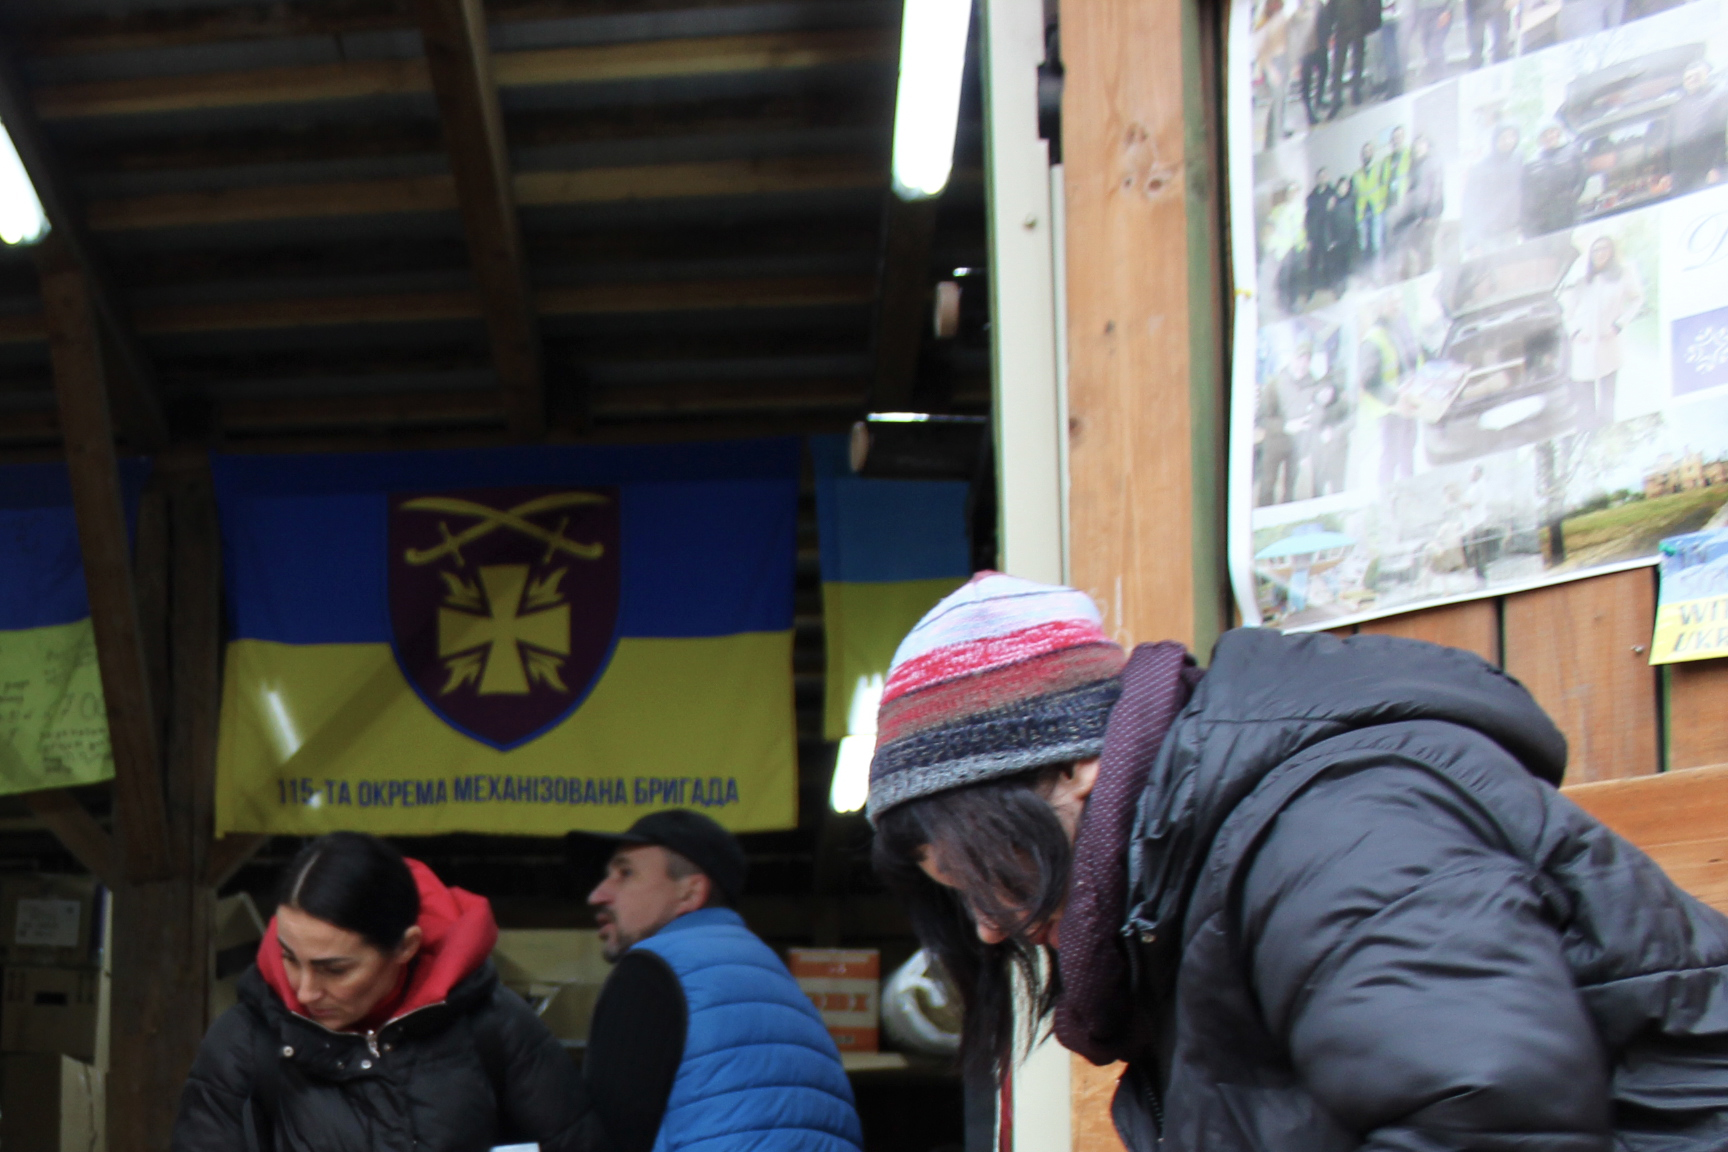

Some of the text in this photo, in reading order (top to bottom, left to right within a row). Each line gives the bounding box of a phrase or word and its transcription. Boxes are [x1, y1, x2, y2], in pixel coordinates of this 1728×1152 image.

[357, 777, 448, 807] ОКРЕМА
[454, 773, 625, 806] МЕХАНІЗОВАНА
[634, 776, 740, 808] БРИГАДА
